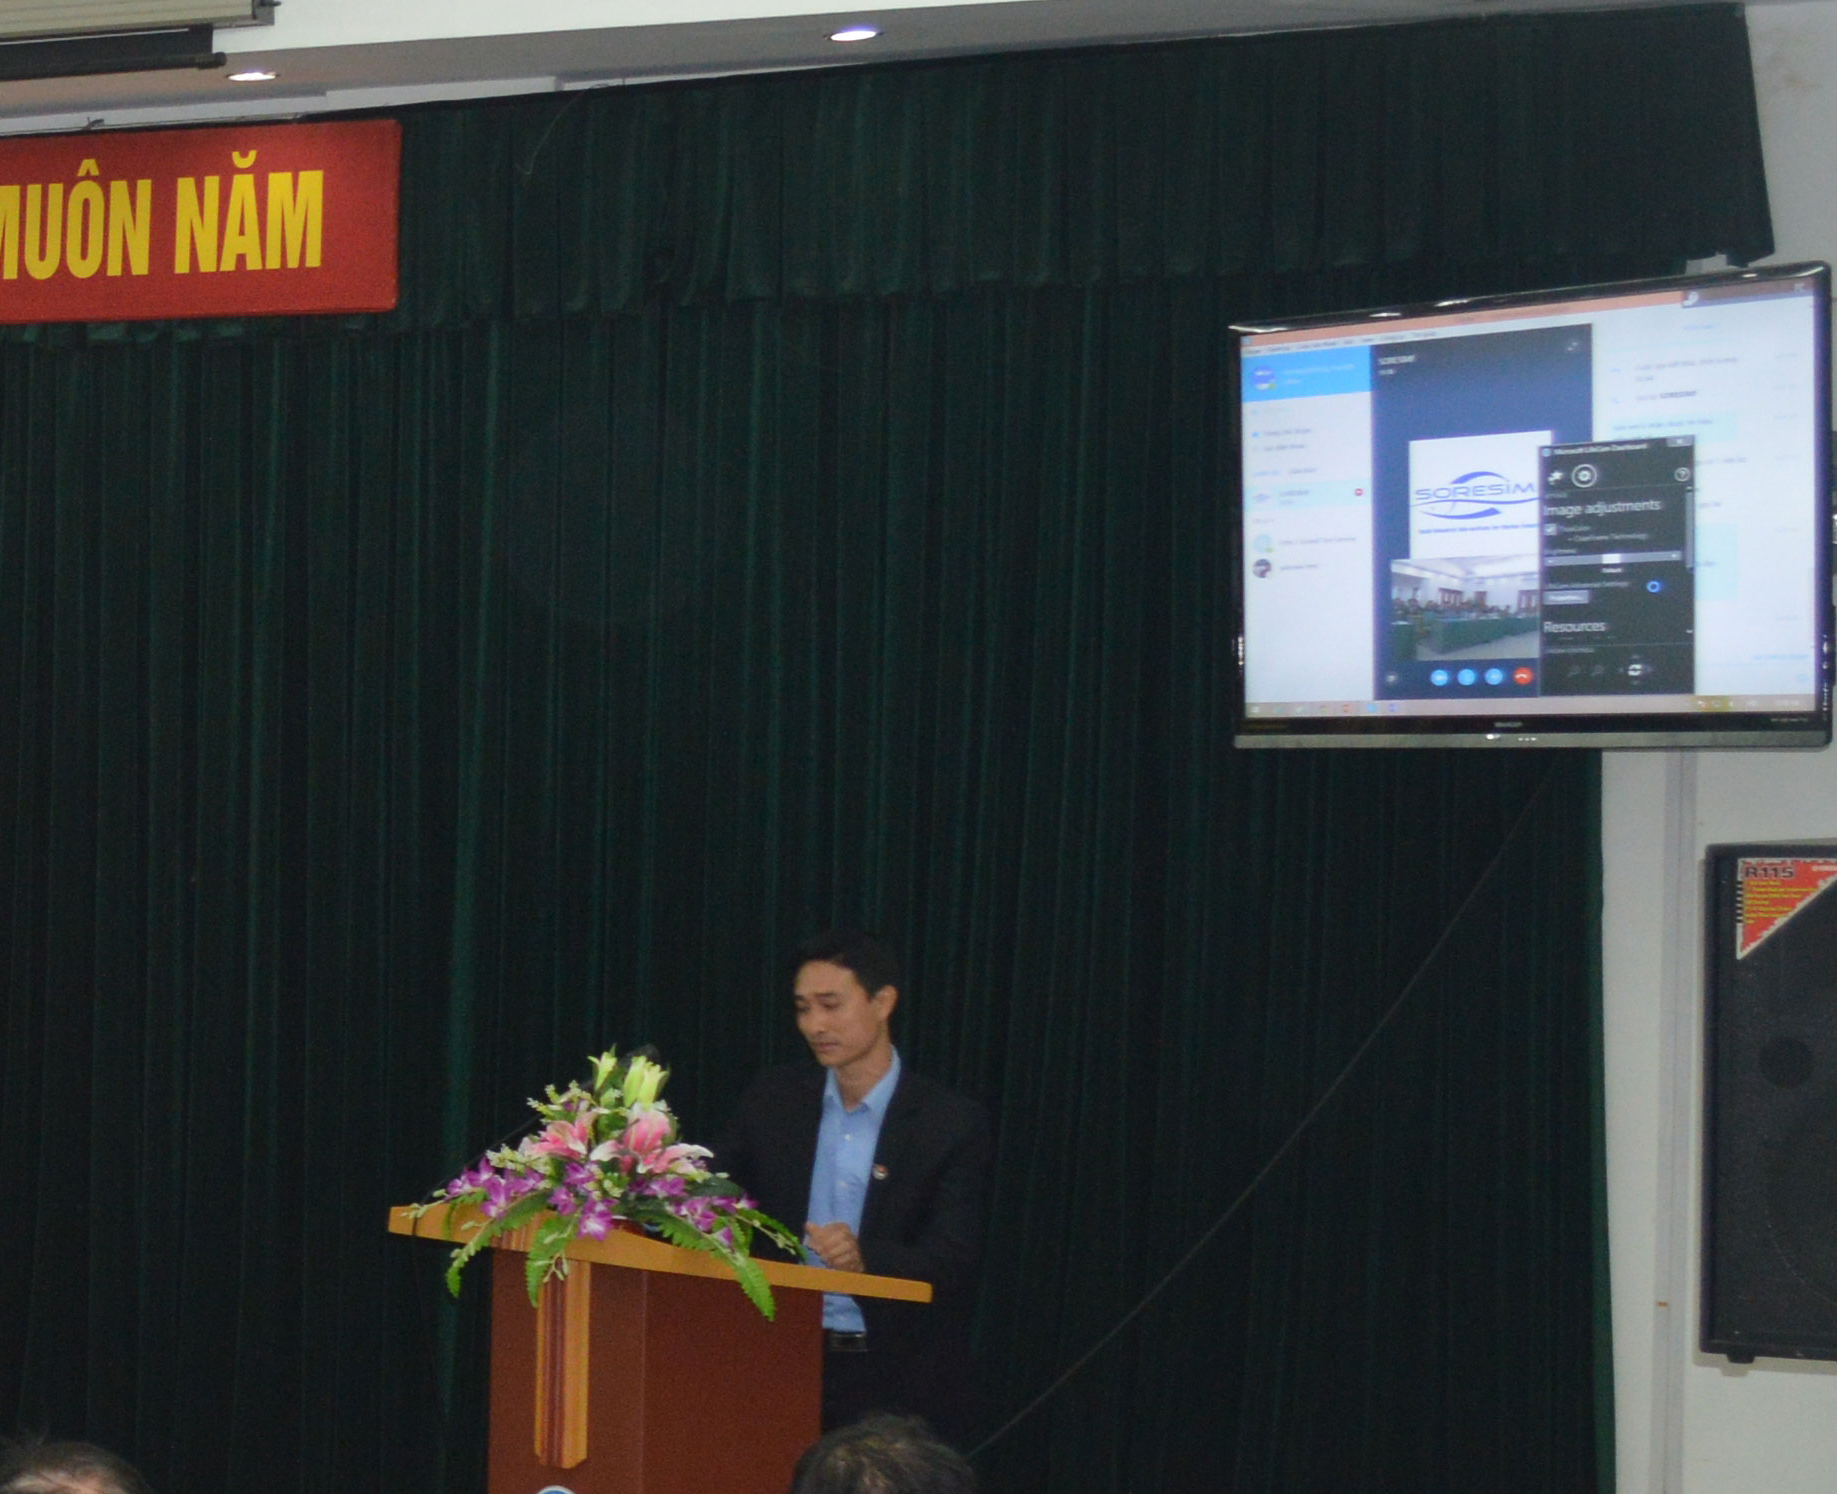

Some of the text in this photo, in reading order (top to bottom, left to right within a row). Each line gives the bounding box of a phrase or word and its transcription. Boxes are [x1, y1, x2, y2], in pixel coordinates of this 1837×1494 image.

[176, 150, 323, 273] NĂM
[1543, 500, 1663, 518] Image adjustments
[1543, 621, 1607, 633] Resources
[1744, 866, 1794, 878] R115
